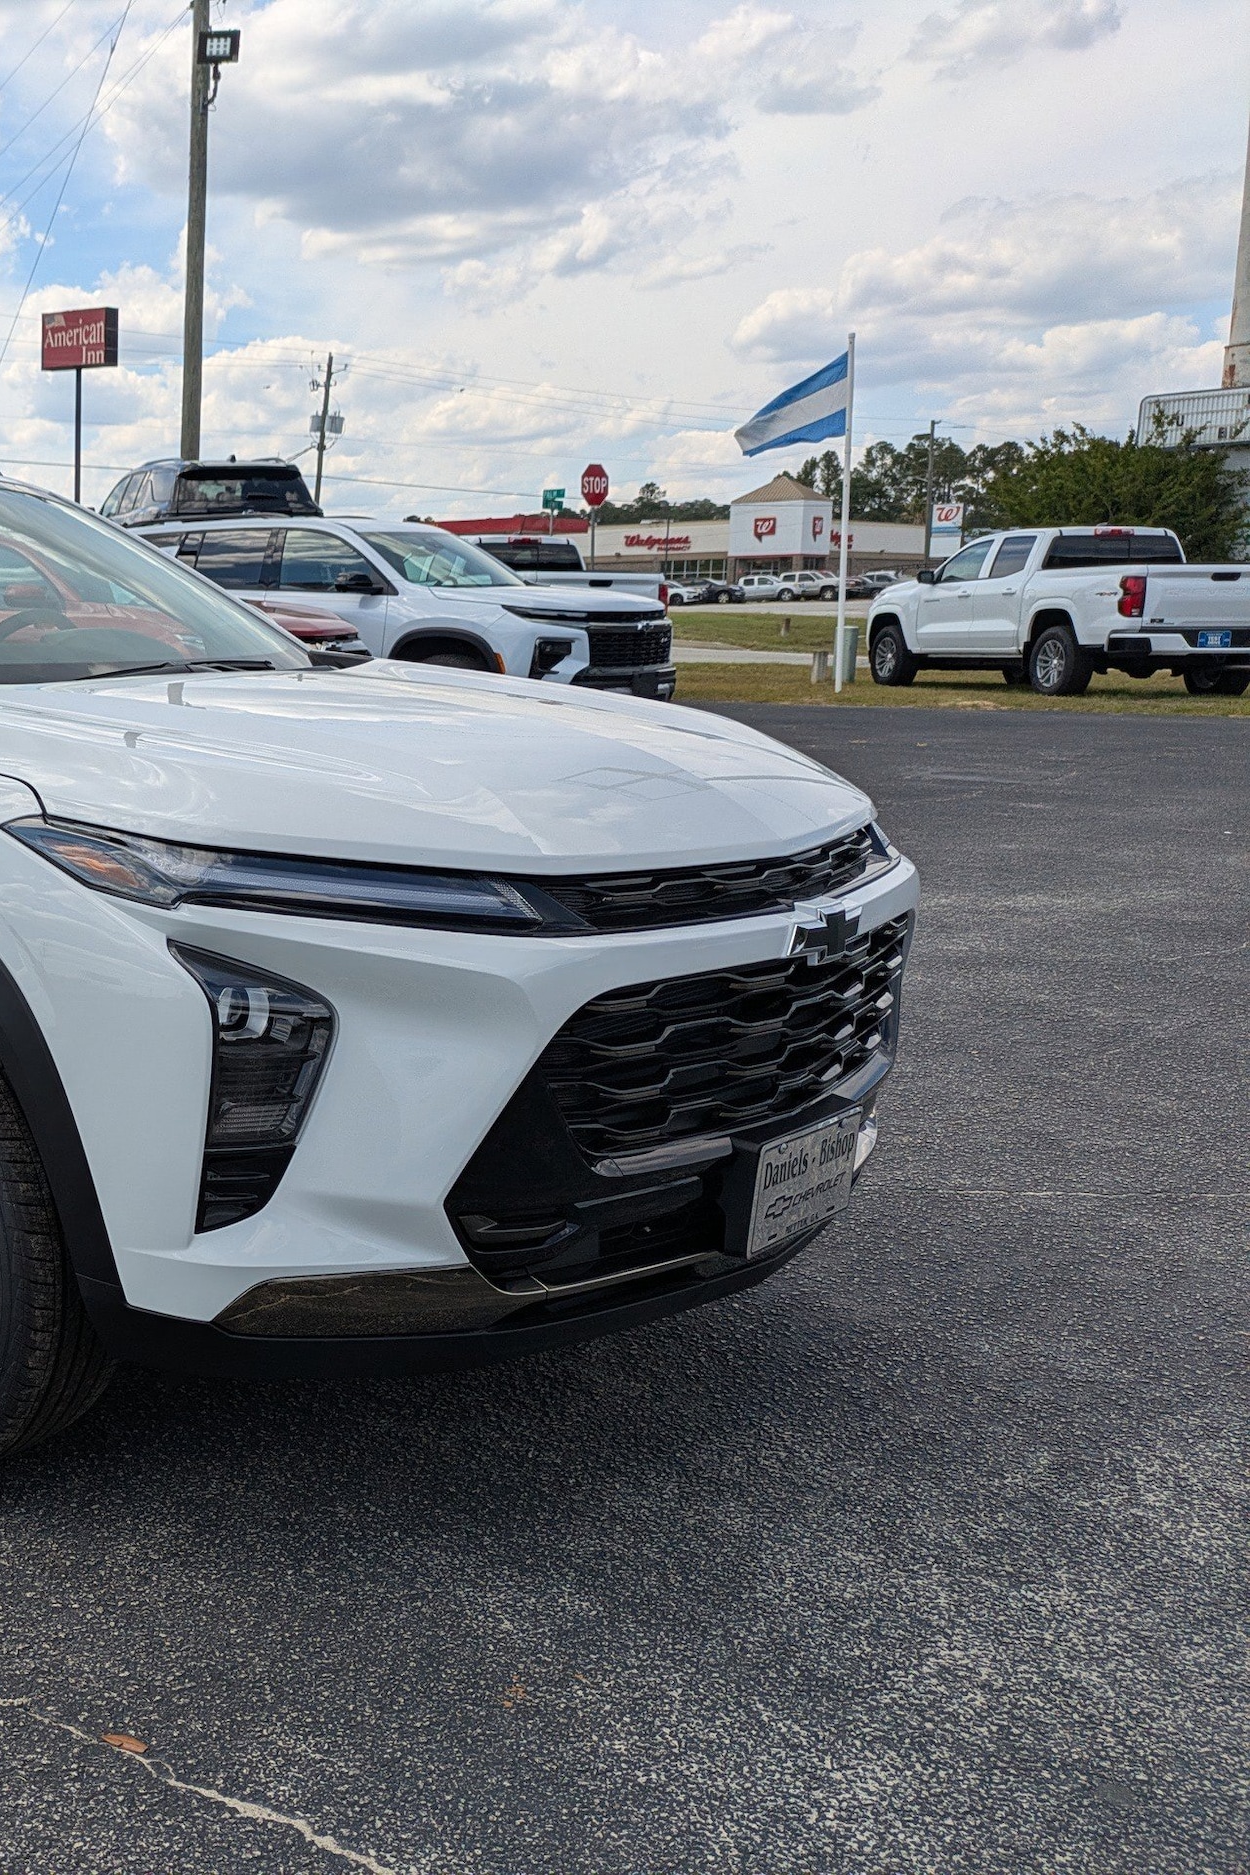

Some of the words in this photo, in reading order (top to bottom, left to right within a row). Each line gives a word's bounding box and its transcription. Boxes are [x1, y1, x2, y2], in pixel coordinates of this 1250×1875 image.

[45, 318, 105, 348] American
[82, 346, 104, 365] Inn
[583, 476, 607, 494] STOP
[936, 506, 961, 522] W
[624, 534, 691, 550] Walgreens
[763, 1146, 808, 1191] Daniels
[819, 1130, 855, 1167] Bishop
[792, 1170, 846, 1207] CHEVROLET
